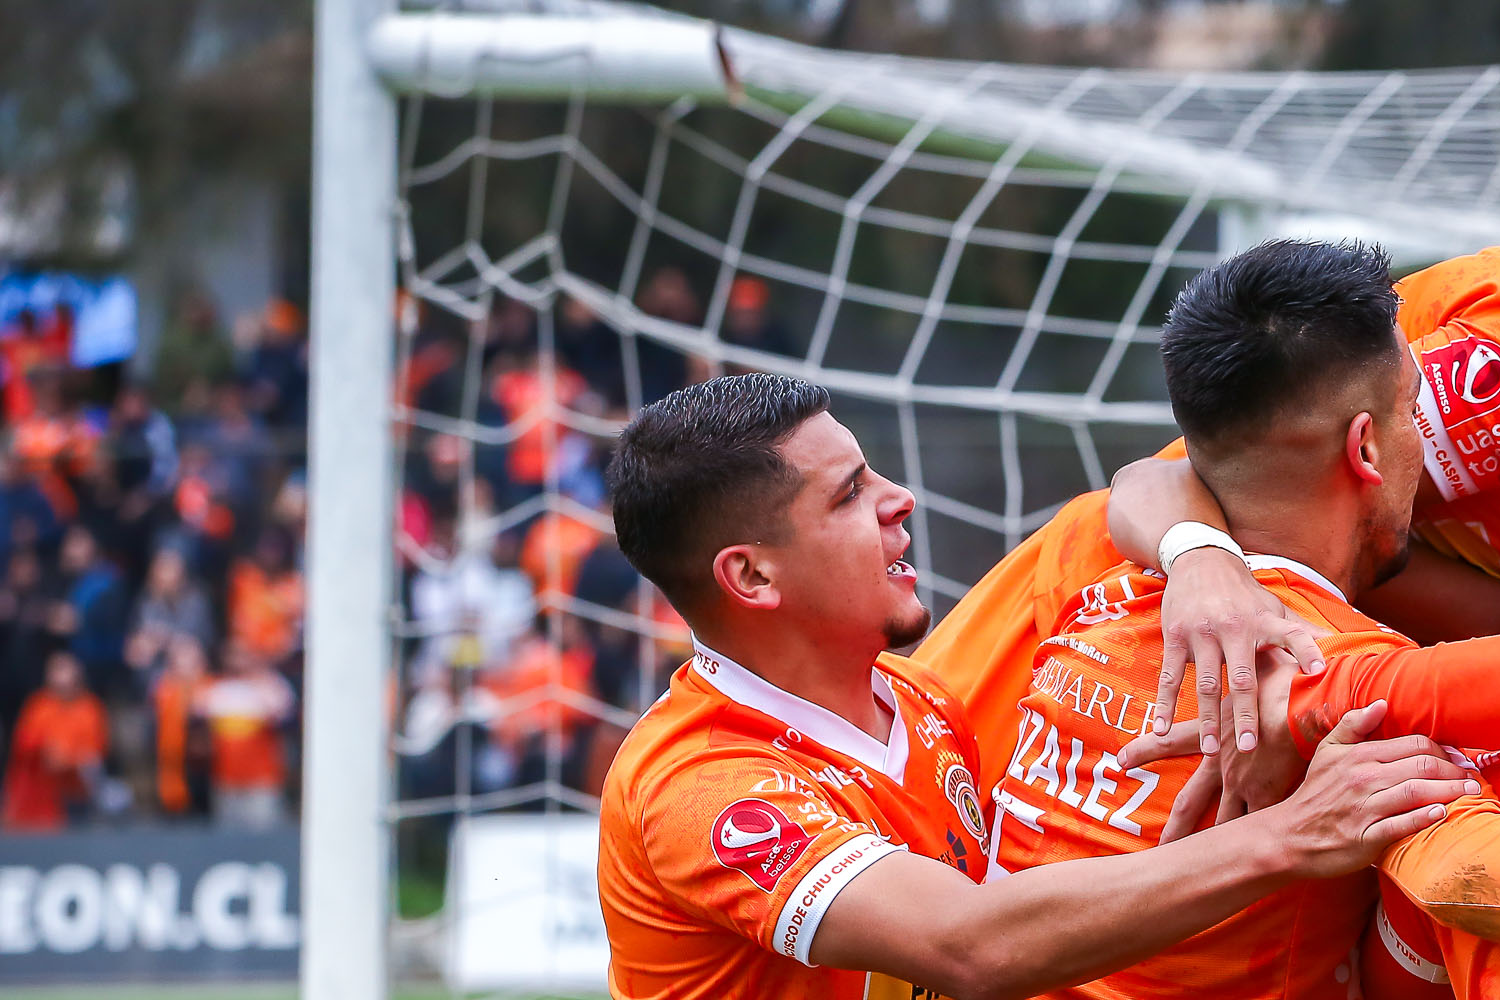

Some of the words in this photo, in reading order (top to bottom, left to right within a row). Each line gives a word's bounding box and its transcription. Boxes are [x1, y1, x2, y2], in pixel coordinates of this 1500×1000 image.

[1430, 362, 1451, 415] Ascenso
[768, 839, 802, 878] betsso
[791, 906, 808, 927] DE
[802, 873, 832, 909] CHIU
[831, 850, 863, 875] CHIU
[1395, 938, 1422, 967] TURI
